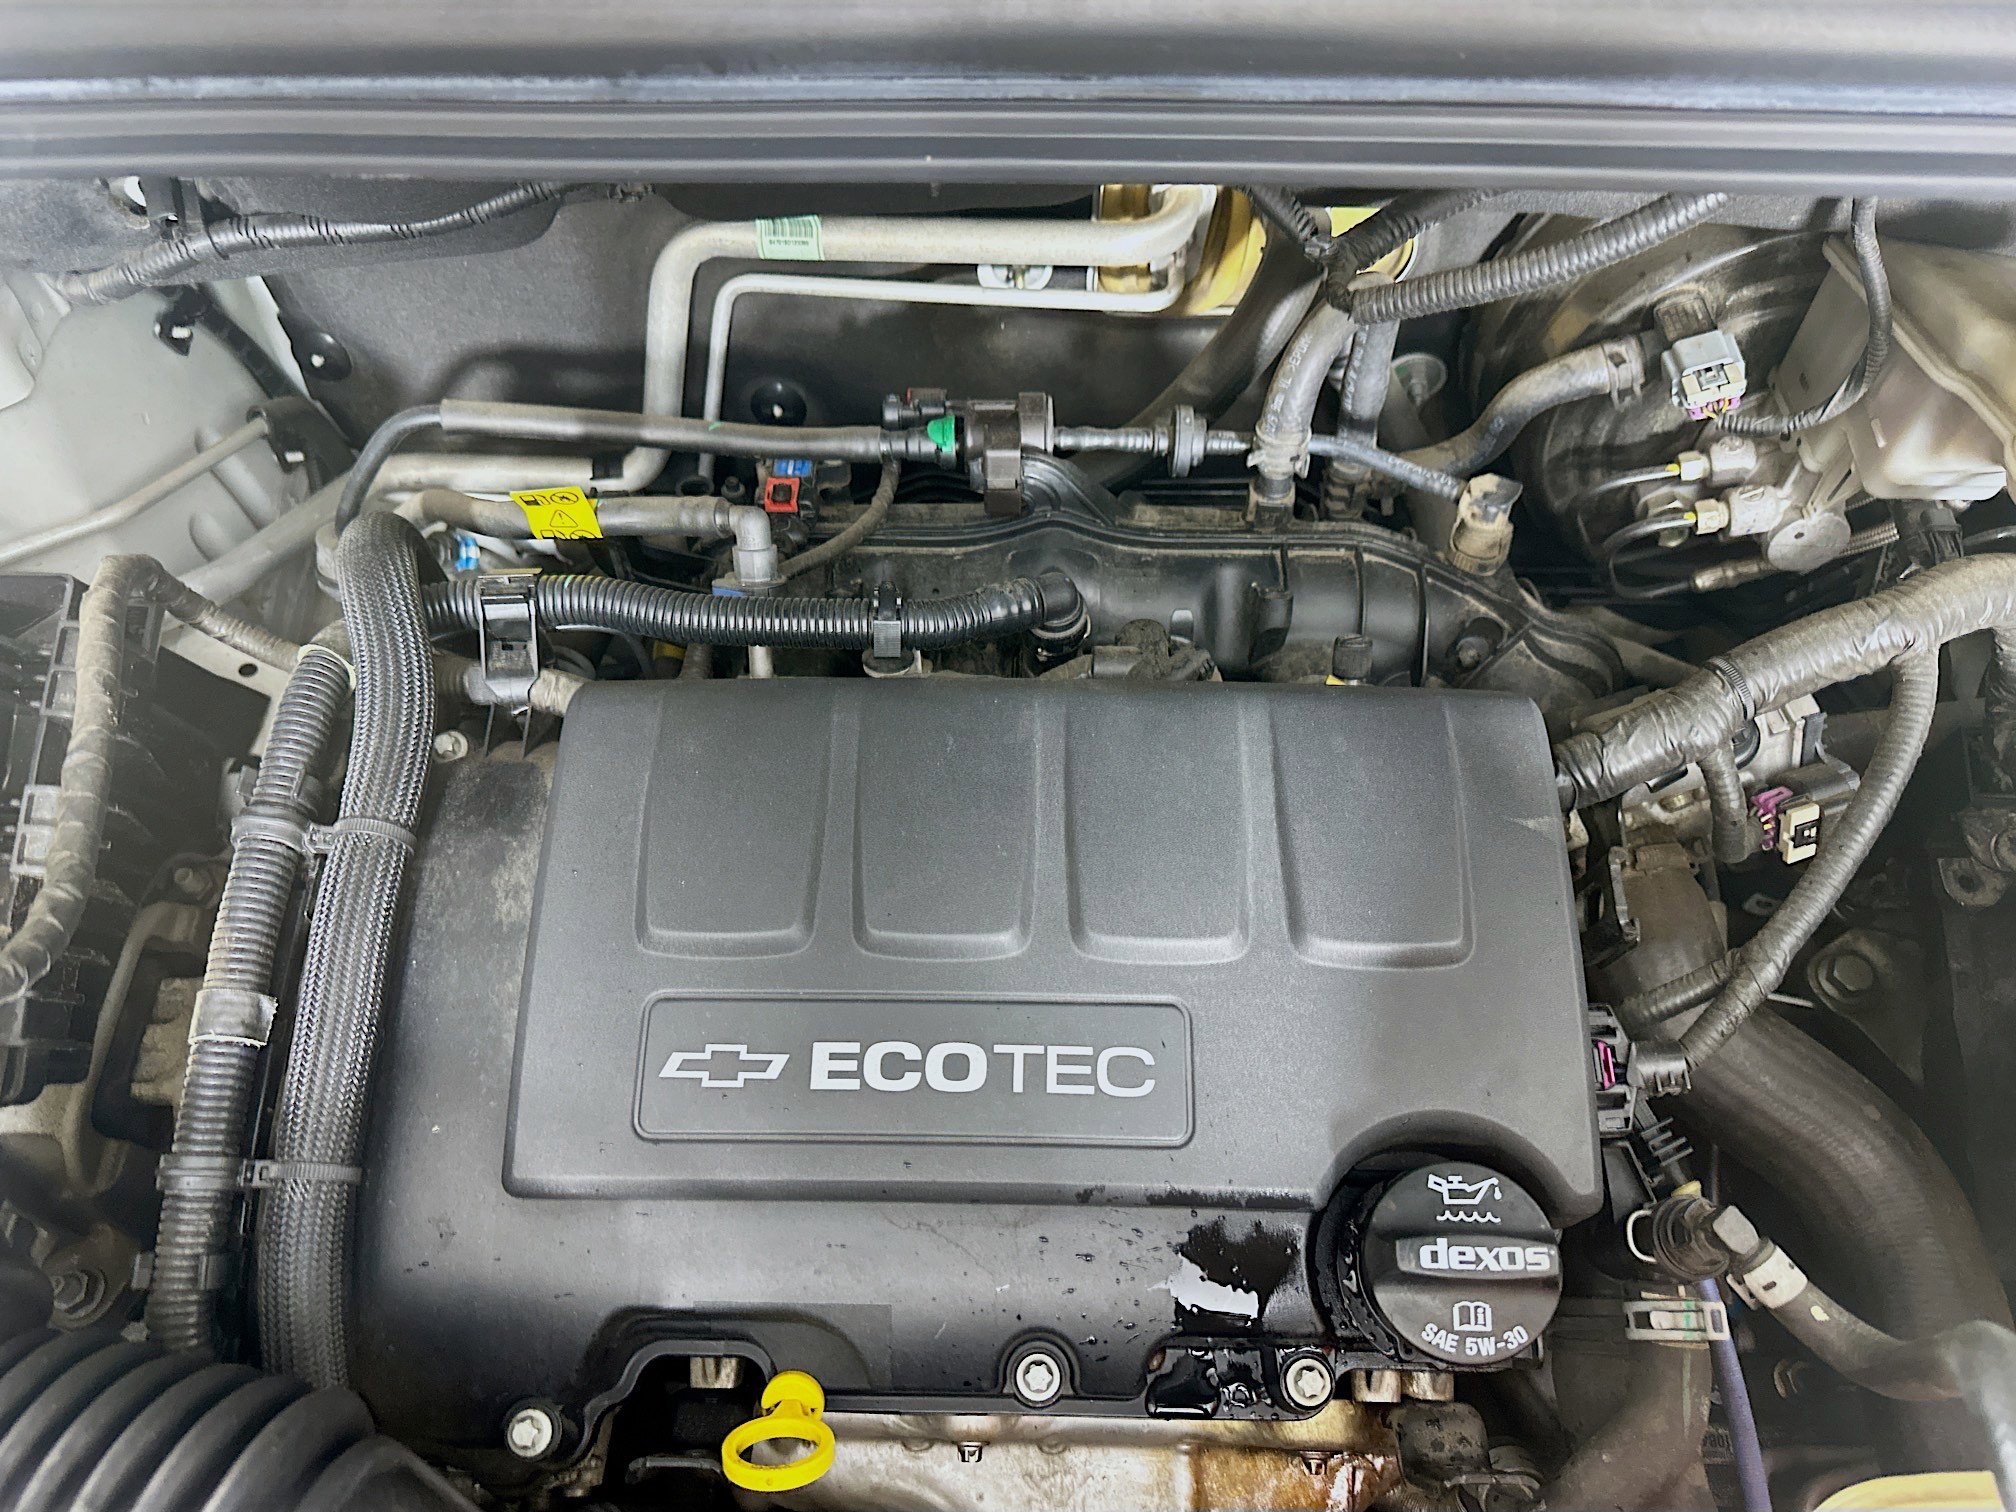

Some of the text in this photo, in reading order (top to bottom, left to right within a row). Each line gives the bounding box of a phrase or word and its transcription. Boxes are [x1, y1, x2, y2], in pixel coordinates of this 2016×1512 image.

[809, 1040, 1156, 1098] ECOTEC
[1419, 1237, 1550, 1272] dexos
[1421, 1322, 1529, 1356] SAE 5W-30
